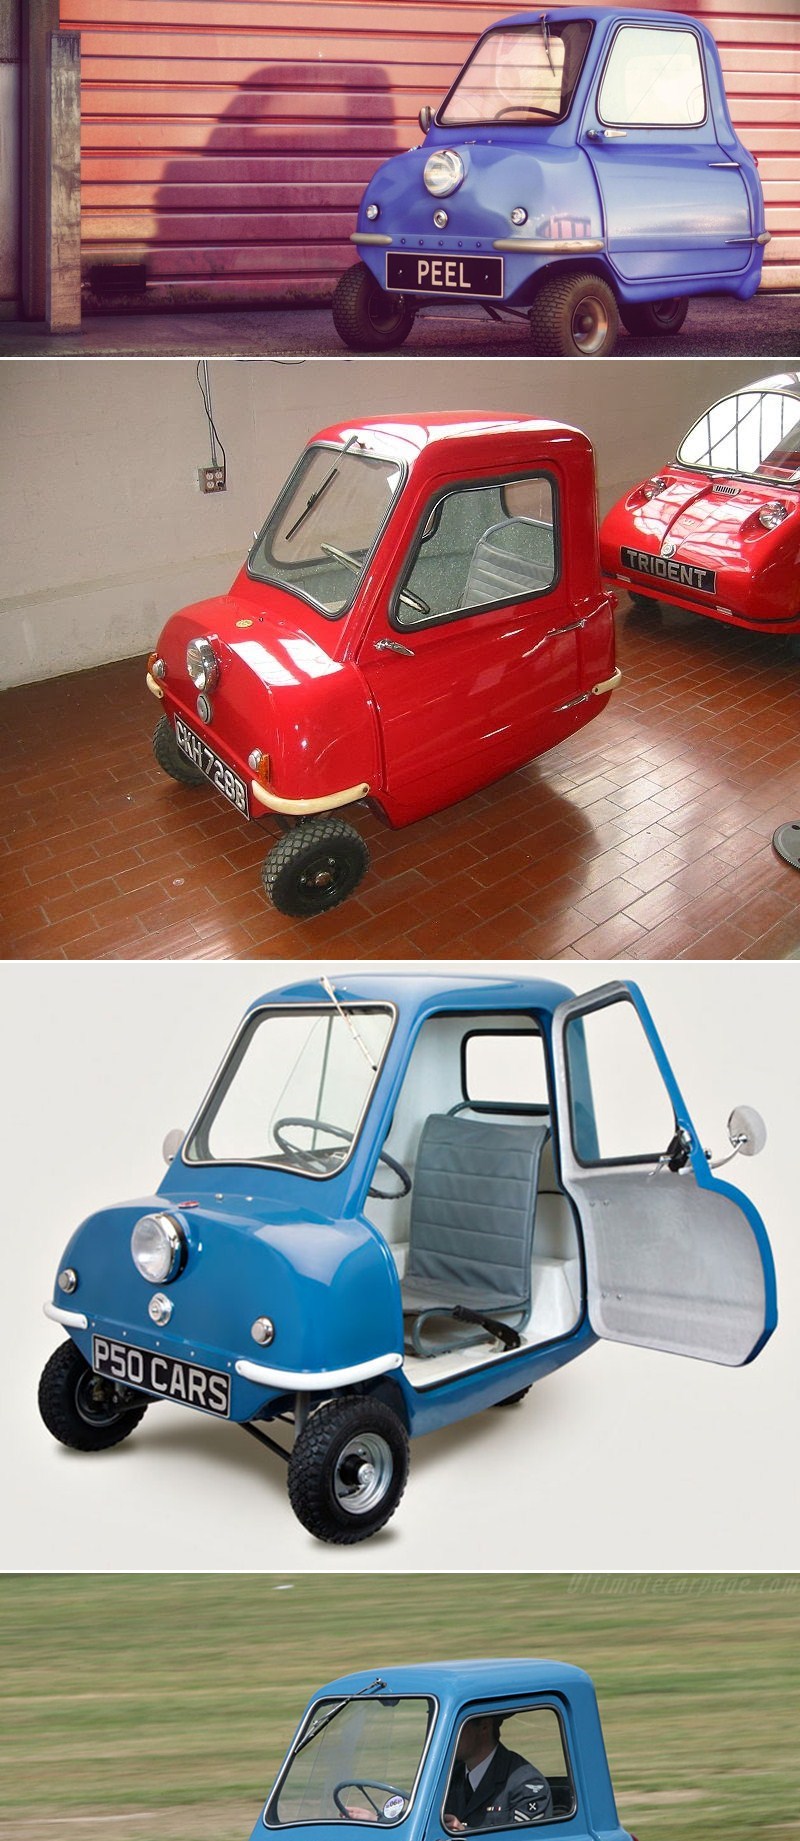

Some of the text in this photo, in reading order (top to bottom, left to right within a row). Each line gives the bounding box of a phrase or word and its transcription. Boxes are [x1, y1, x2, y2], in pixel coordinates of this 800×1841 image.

[418, 260, 471, 288] PEEL
[626, 549, 706, 588] TRIDENT
[176, 721, 246, 811] CKH 728B
[94, 1338, 227, 1411] P50 CARS
